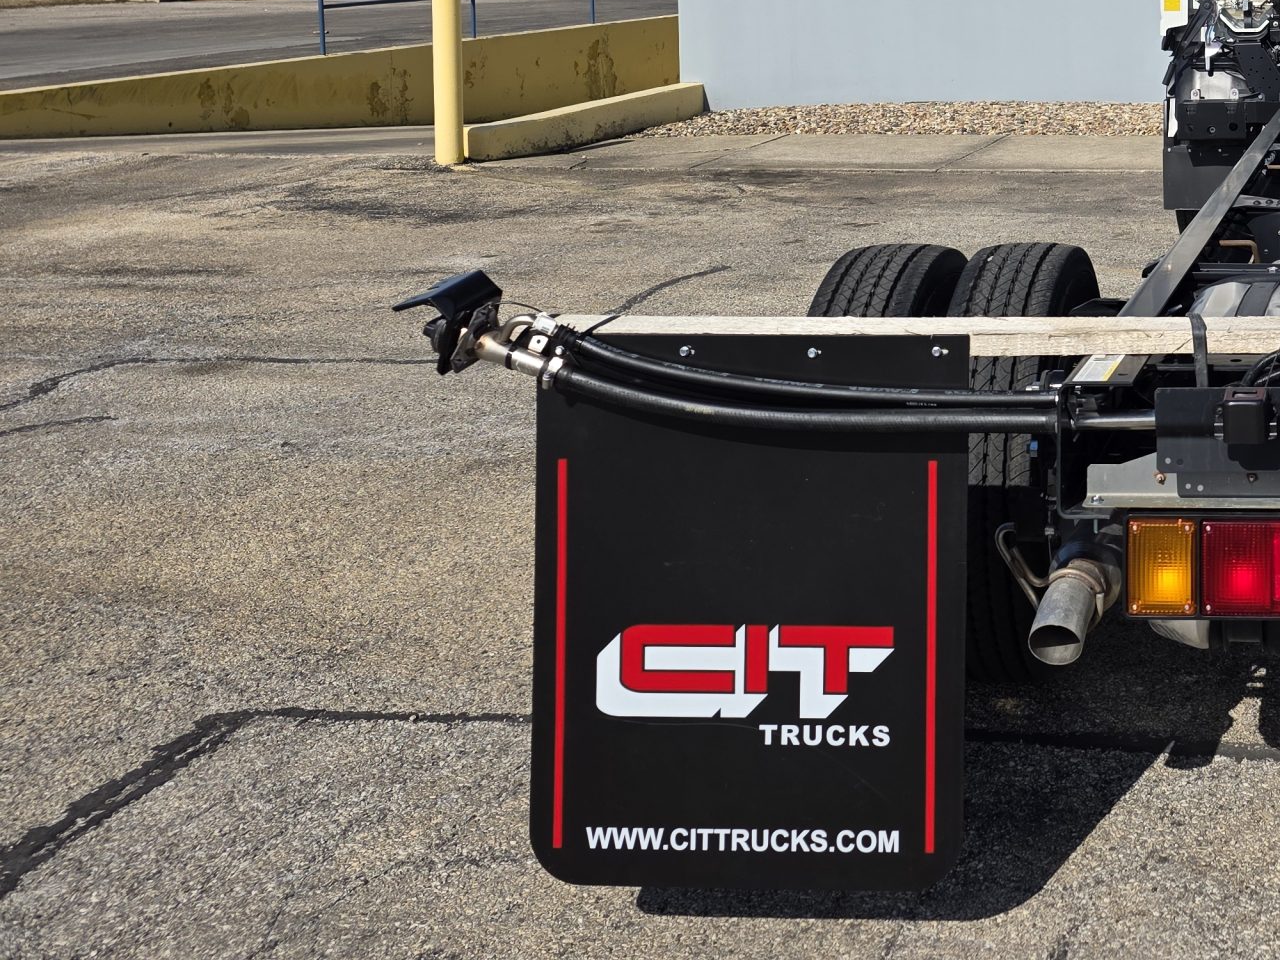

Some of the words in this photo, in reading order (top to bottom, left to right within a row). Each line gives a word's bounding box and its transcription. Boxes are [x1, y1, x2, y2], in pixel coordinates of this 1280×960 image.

[596, 624, 894, 719] CIT
[759, 723, 891, 747] TRUCKS
[585, 826, 900, 854] WWW.CITTRUCKS.COM
